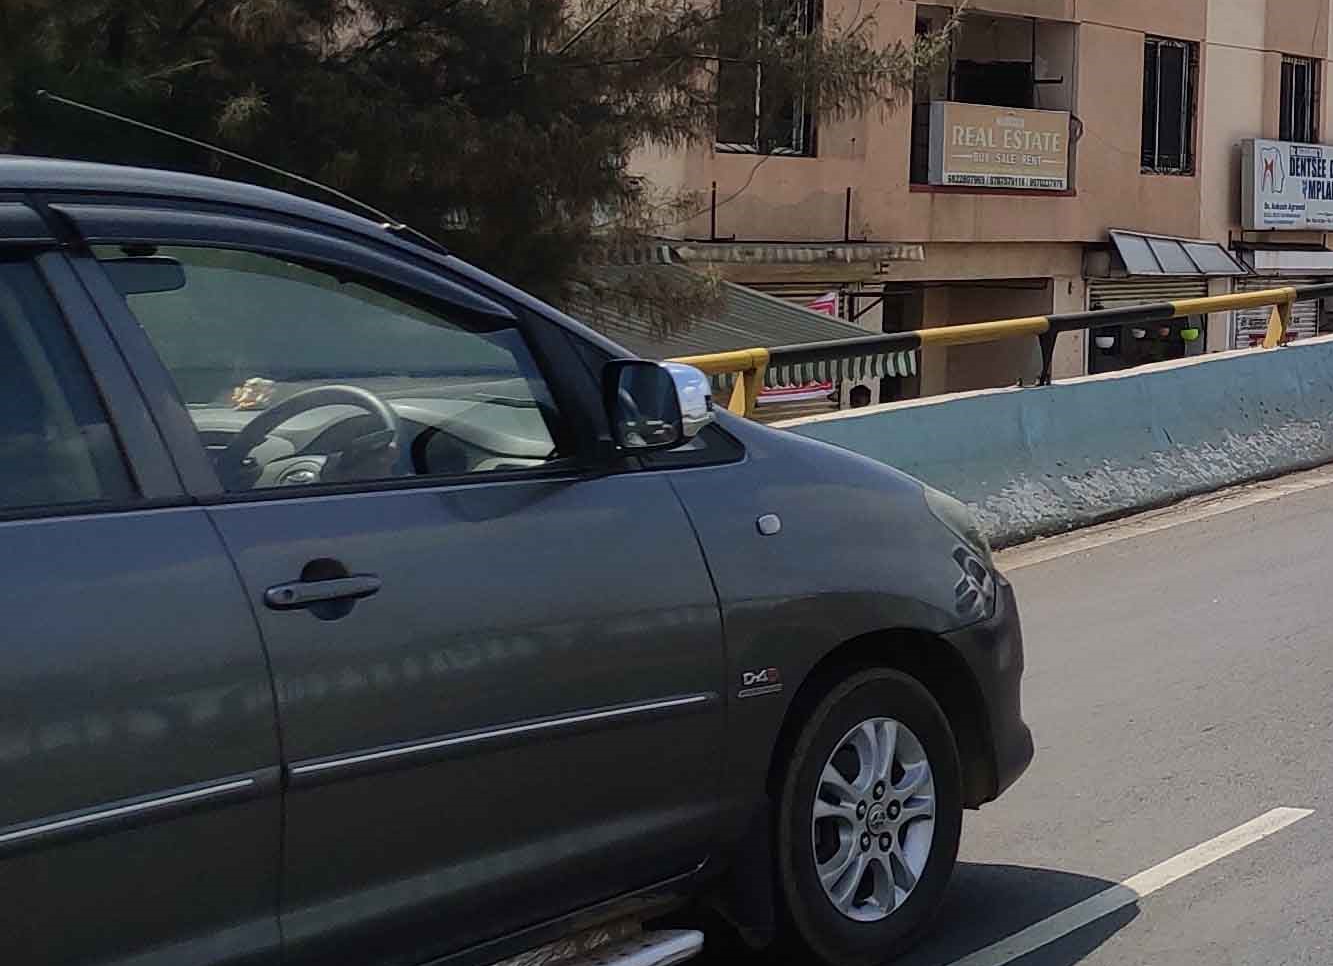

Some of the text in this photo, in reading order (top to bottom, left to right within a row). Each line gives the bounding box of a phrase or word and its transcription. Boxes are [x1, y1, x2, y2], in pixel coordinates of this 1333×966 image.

[952, 124, 1062, 153] REAL ESTATE
[1289, 156, 1326, 178] DENTSEE
